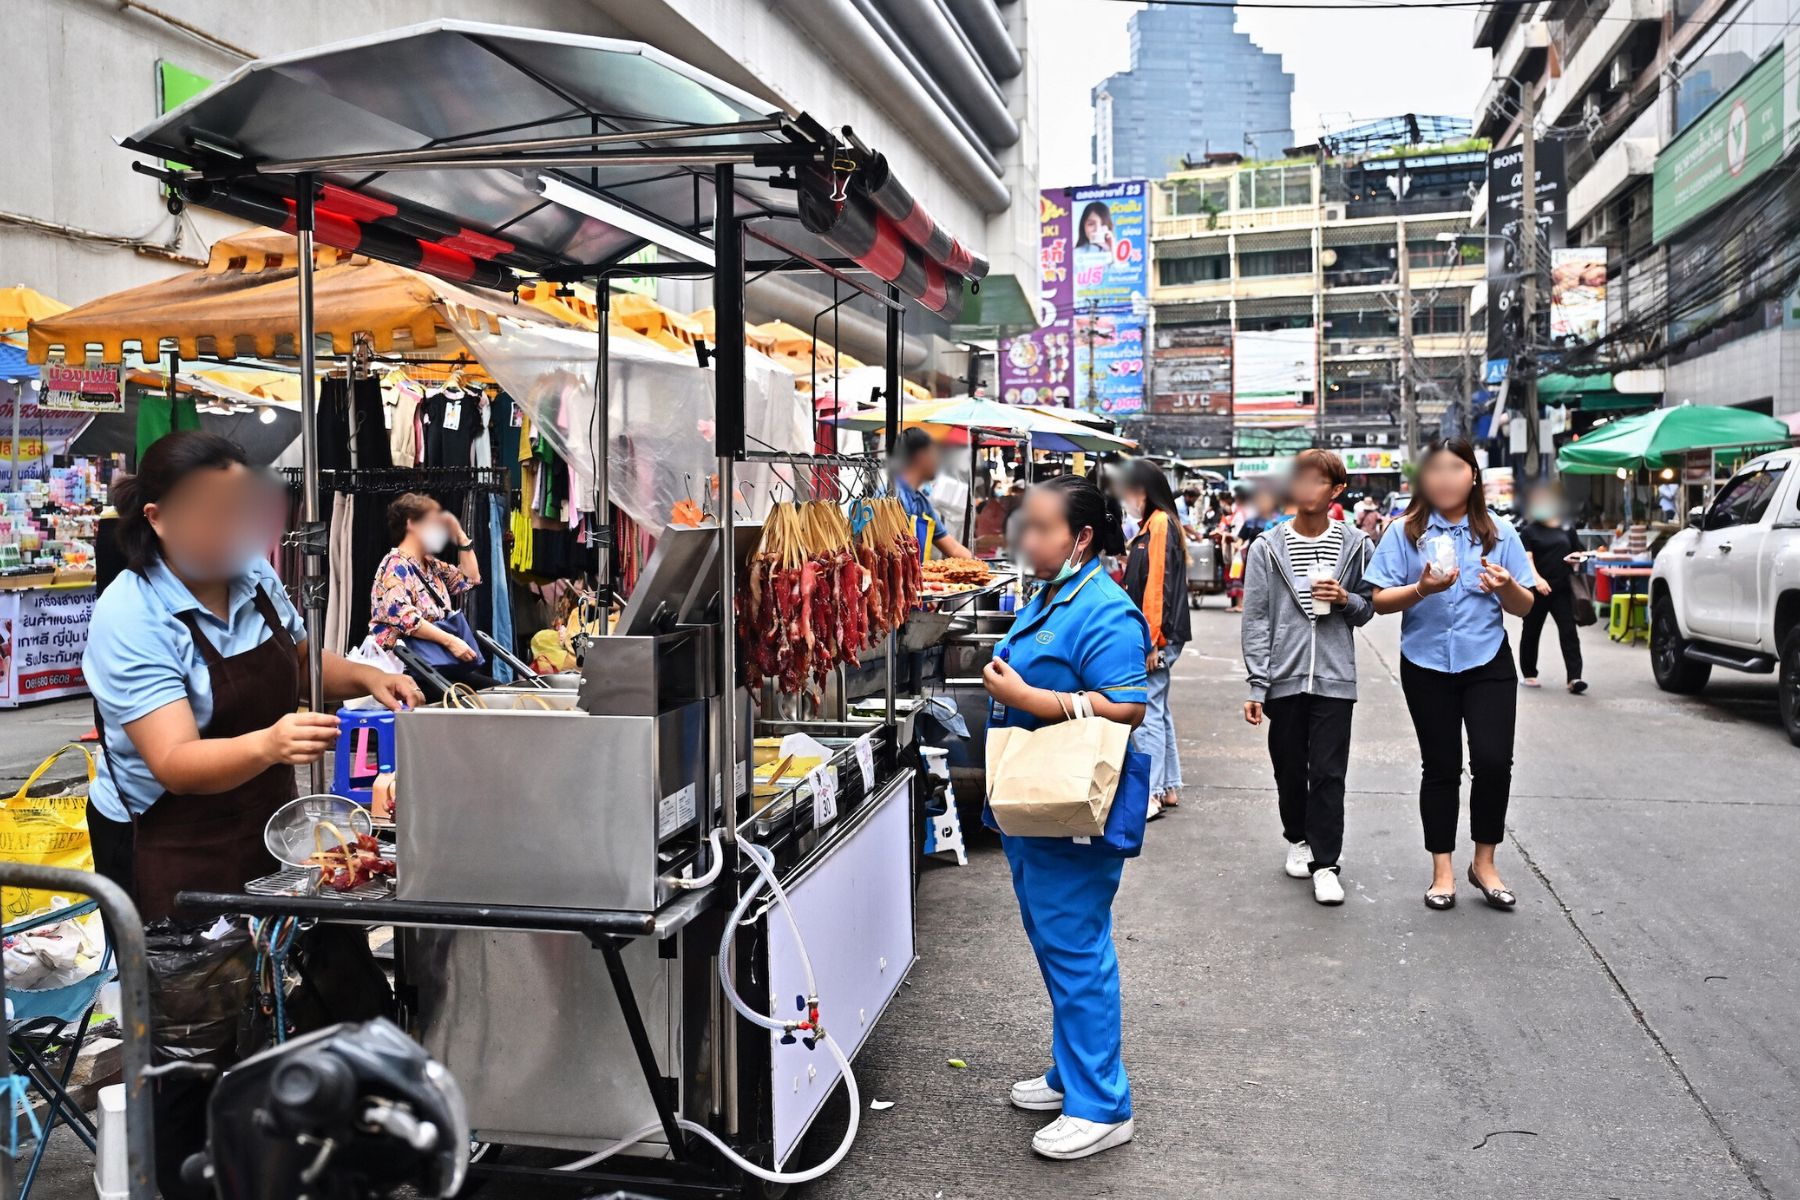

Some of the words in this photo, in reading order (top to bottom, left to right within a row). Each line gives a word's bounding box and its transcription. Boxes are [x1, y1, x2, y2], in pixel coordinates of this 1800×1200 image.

[1493, 152, 1524, 170] SONY
[1077, 264, 1104, 285] ฟรี
[1173, 394, 1210, 407] JVC
[53, 627, 80, 648] ญี่ปุ่น
